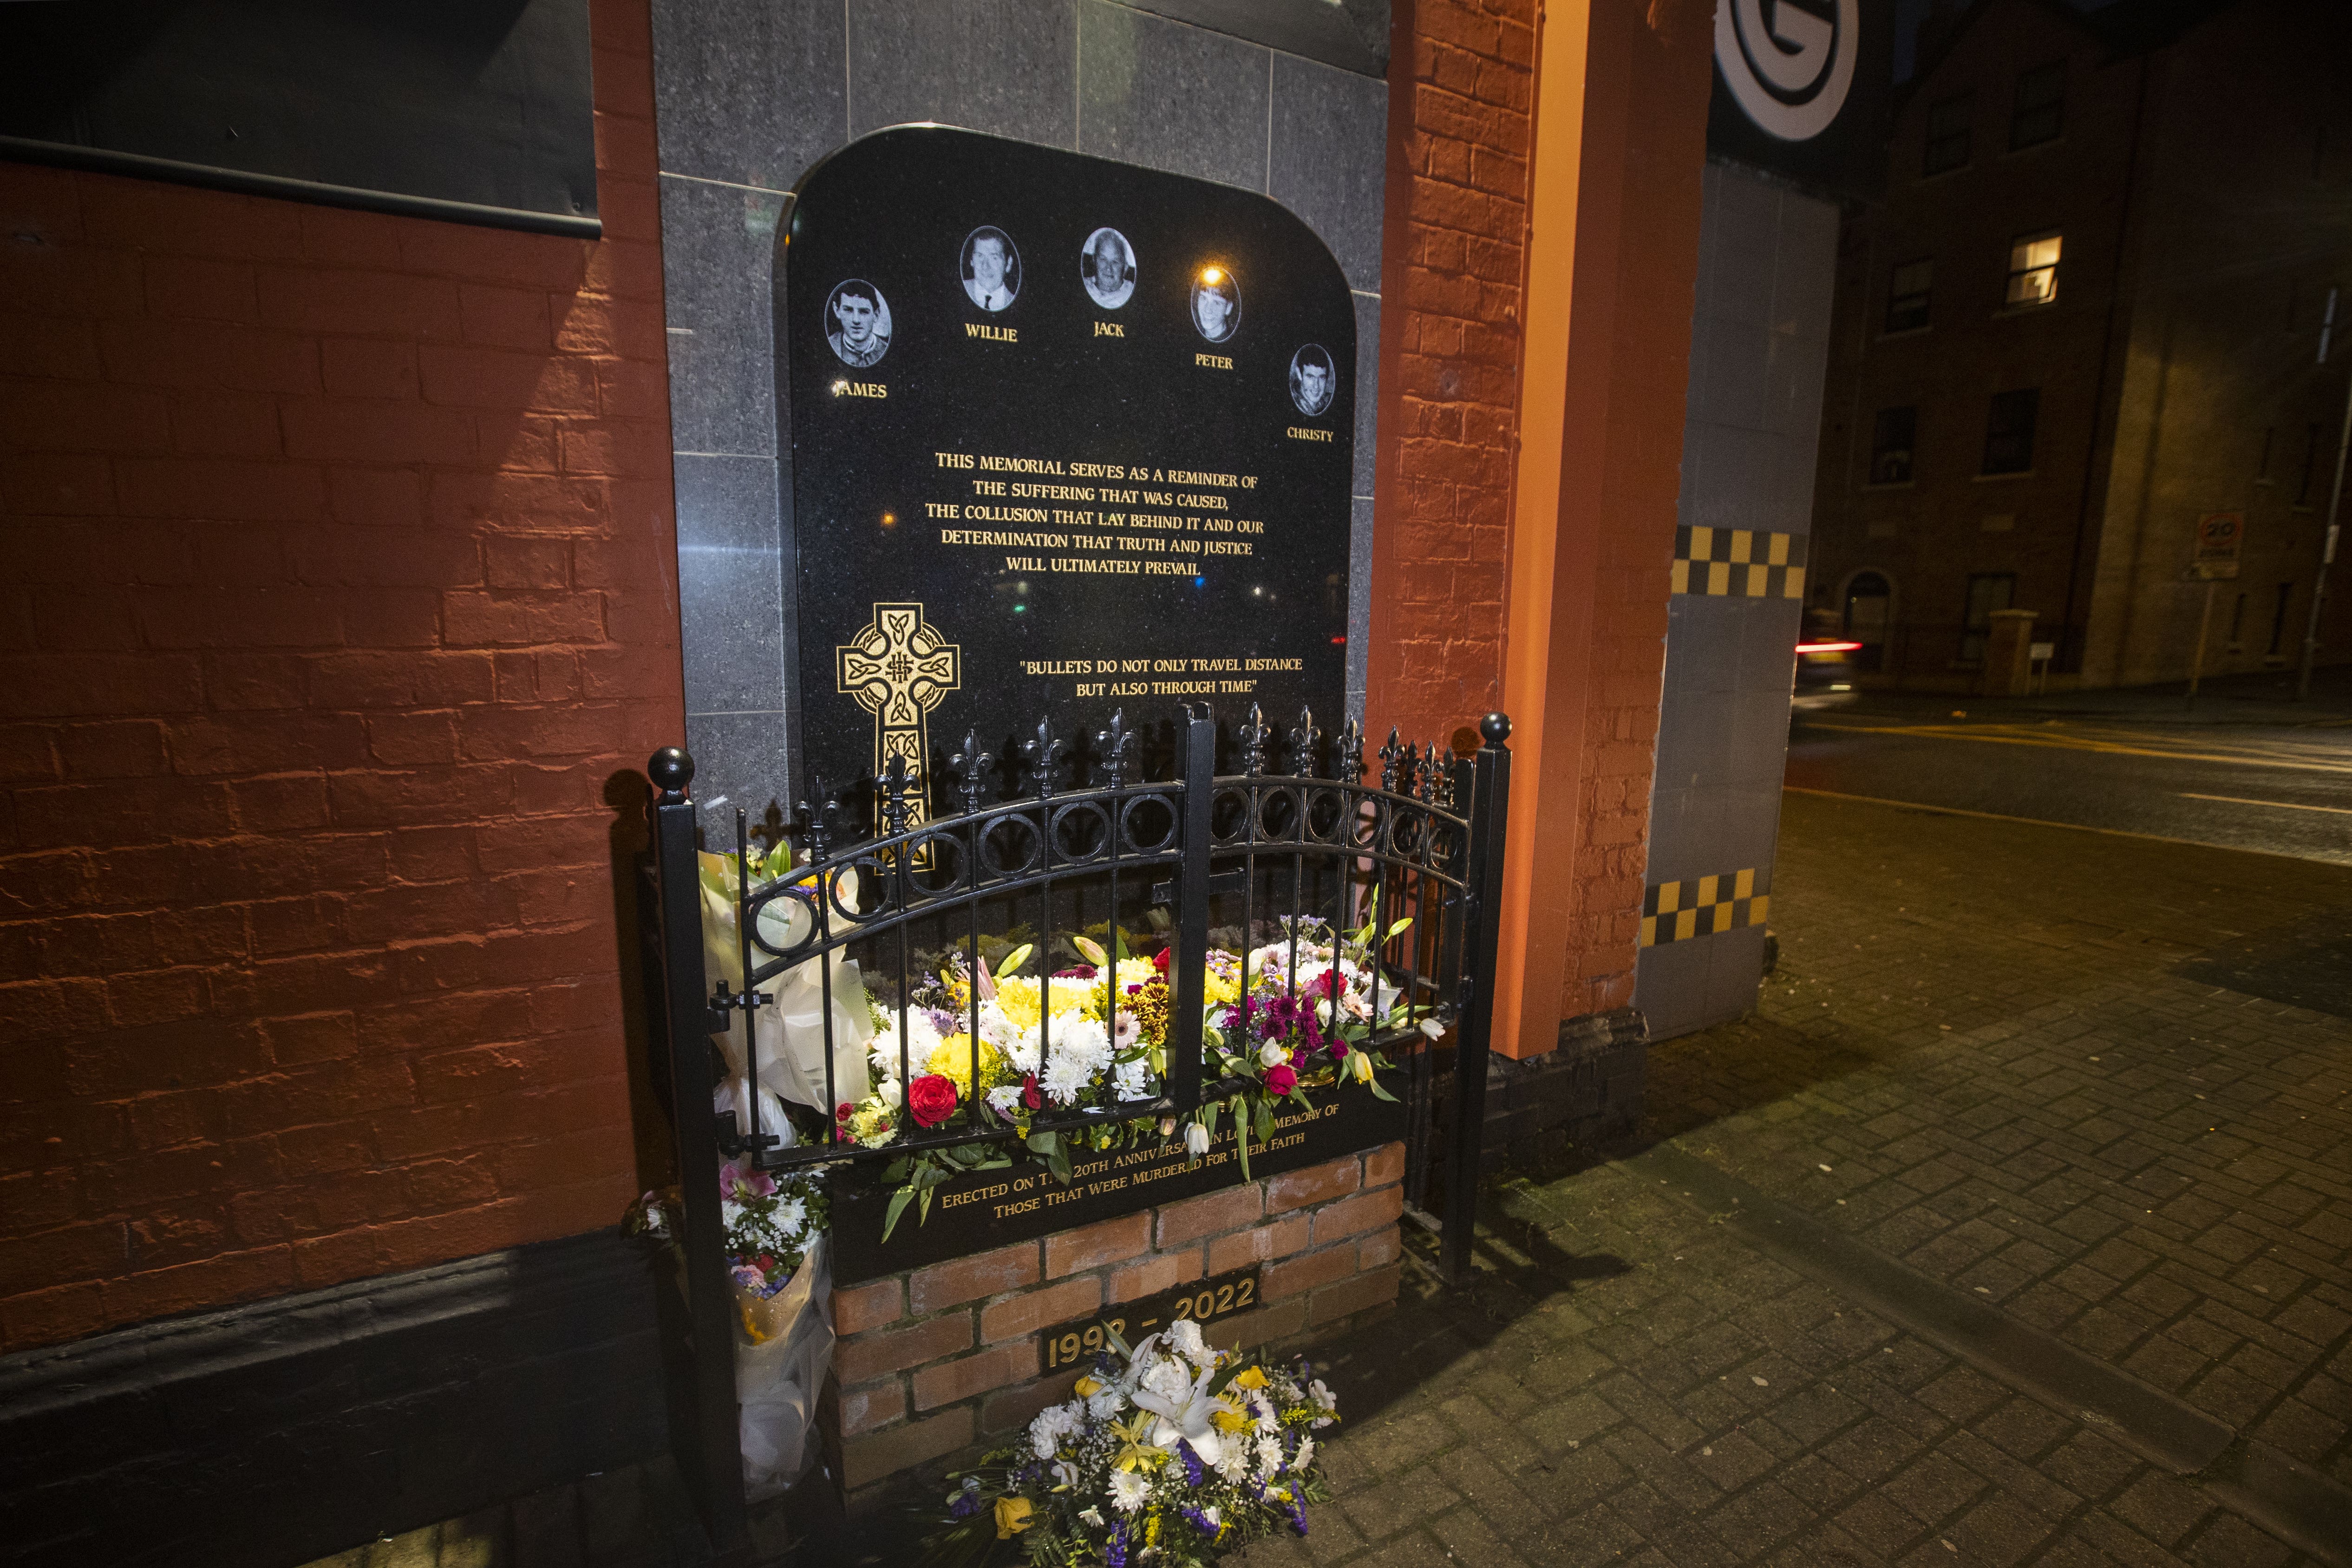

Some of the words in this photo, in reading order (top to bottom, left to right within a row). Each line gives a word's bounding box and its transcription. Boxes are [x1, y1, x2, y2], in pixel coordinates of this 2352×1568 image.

[965, 323, 1017, 342] WILLIE
[1094, 321, 1124, 337] JACK
[1196, 353, 1233, 369] PETER
[834, 380, 888, 399] JAMES
[1287, 427, 1333, 442] CHRISTY
[935, 453, 974, 469] THIS
[980, 456, 1065, 475] MEMORIAL
[1070, 463, 1124, 479] SERVES
[1129, 467, 1148, 481] AS
[1153, 469, 1163, 482] A
[1168, 470, 1238, 487] REMINDER
[1241, 476, 1258, 488] OF
[973, 481, 1006, 496] THE
[1012, 483, 1095, 501] SUFFERING
[1099, 489, 1139, 503] THAT
[1143, 491, 1172, 506] WAS
[1177, 494, 1228, 510] CAUSED,
[925, 503, 959, 518] THE
[965, 505, 1048, 522] COLLUSION
[1052, 510, 1094, 525] THAT
[1098, 512, 1125, 526] LAY
[1130, 514, 1183, 529] BEHIND
[1187, 517, 1200, 530] IT
[1204, 518, 1233, 532] AND
[1237, 521, 1263, 533] OUR
[2207, 523, 2235, 537] 20
[941, 529, 1068, 548] DETERMINATION
[1072, 535, 1113, 549] THAT
[1117, 537, 1165, 551] TRUTH
[1170, 540, 1200, 553] AND
[1204, 541, 1252, 555] JUSTICE
[1006, 557, 1046, 571] WILL
[1051, 559, 1140, 574] ULTIMATELY
[1145, 562, 1199, 575] PREVAIL
[1020, 660, 1091, 674] "BULLETS
[1097, 660, 1117, 673] DO
[1122, 660, 1150, 673] NOT
[1154, 660, 1188, 672] ONLY
[1191, 659, 1241, 671] TRAVEL
[1245, 659, 1302, 670] DISTANCE
[1077, 683, 1105, 696] BUT
[1110, 682, 1148, 695] ALSO
[1152, 681, 1215, 694] THROUGH
[1220, 680, 1256, 693] TIME"
[942, 1183, 1008, 1209] ERECTED
[1013, 1177, 1033, 1191] ON
[1074, 1160, 1108, 1177] 20TH
[1209, 1132, 1222, 1146] N
[1274, 1107, 1321, 1129] MEMORY
[1325, 1104, 1339, 1116] OF
[994, 1198, 1040, 1218] THOSE
[1045, 1187, 1083, 1205] THAT
[1088, 1177, 1127, 1195] WERE
[1206, 1152, 1228, 1166] FOR
[1231, 1141, 1267, 1160] TEIR
[1271, 1133, 1304, 1150] FAITH
[1175, 1278, 1254, 1321] 2022
